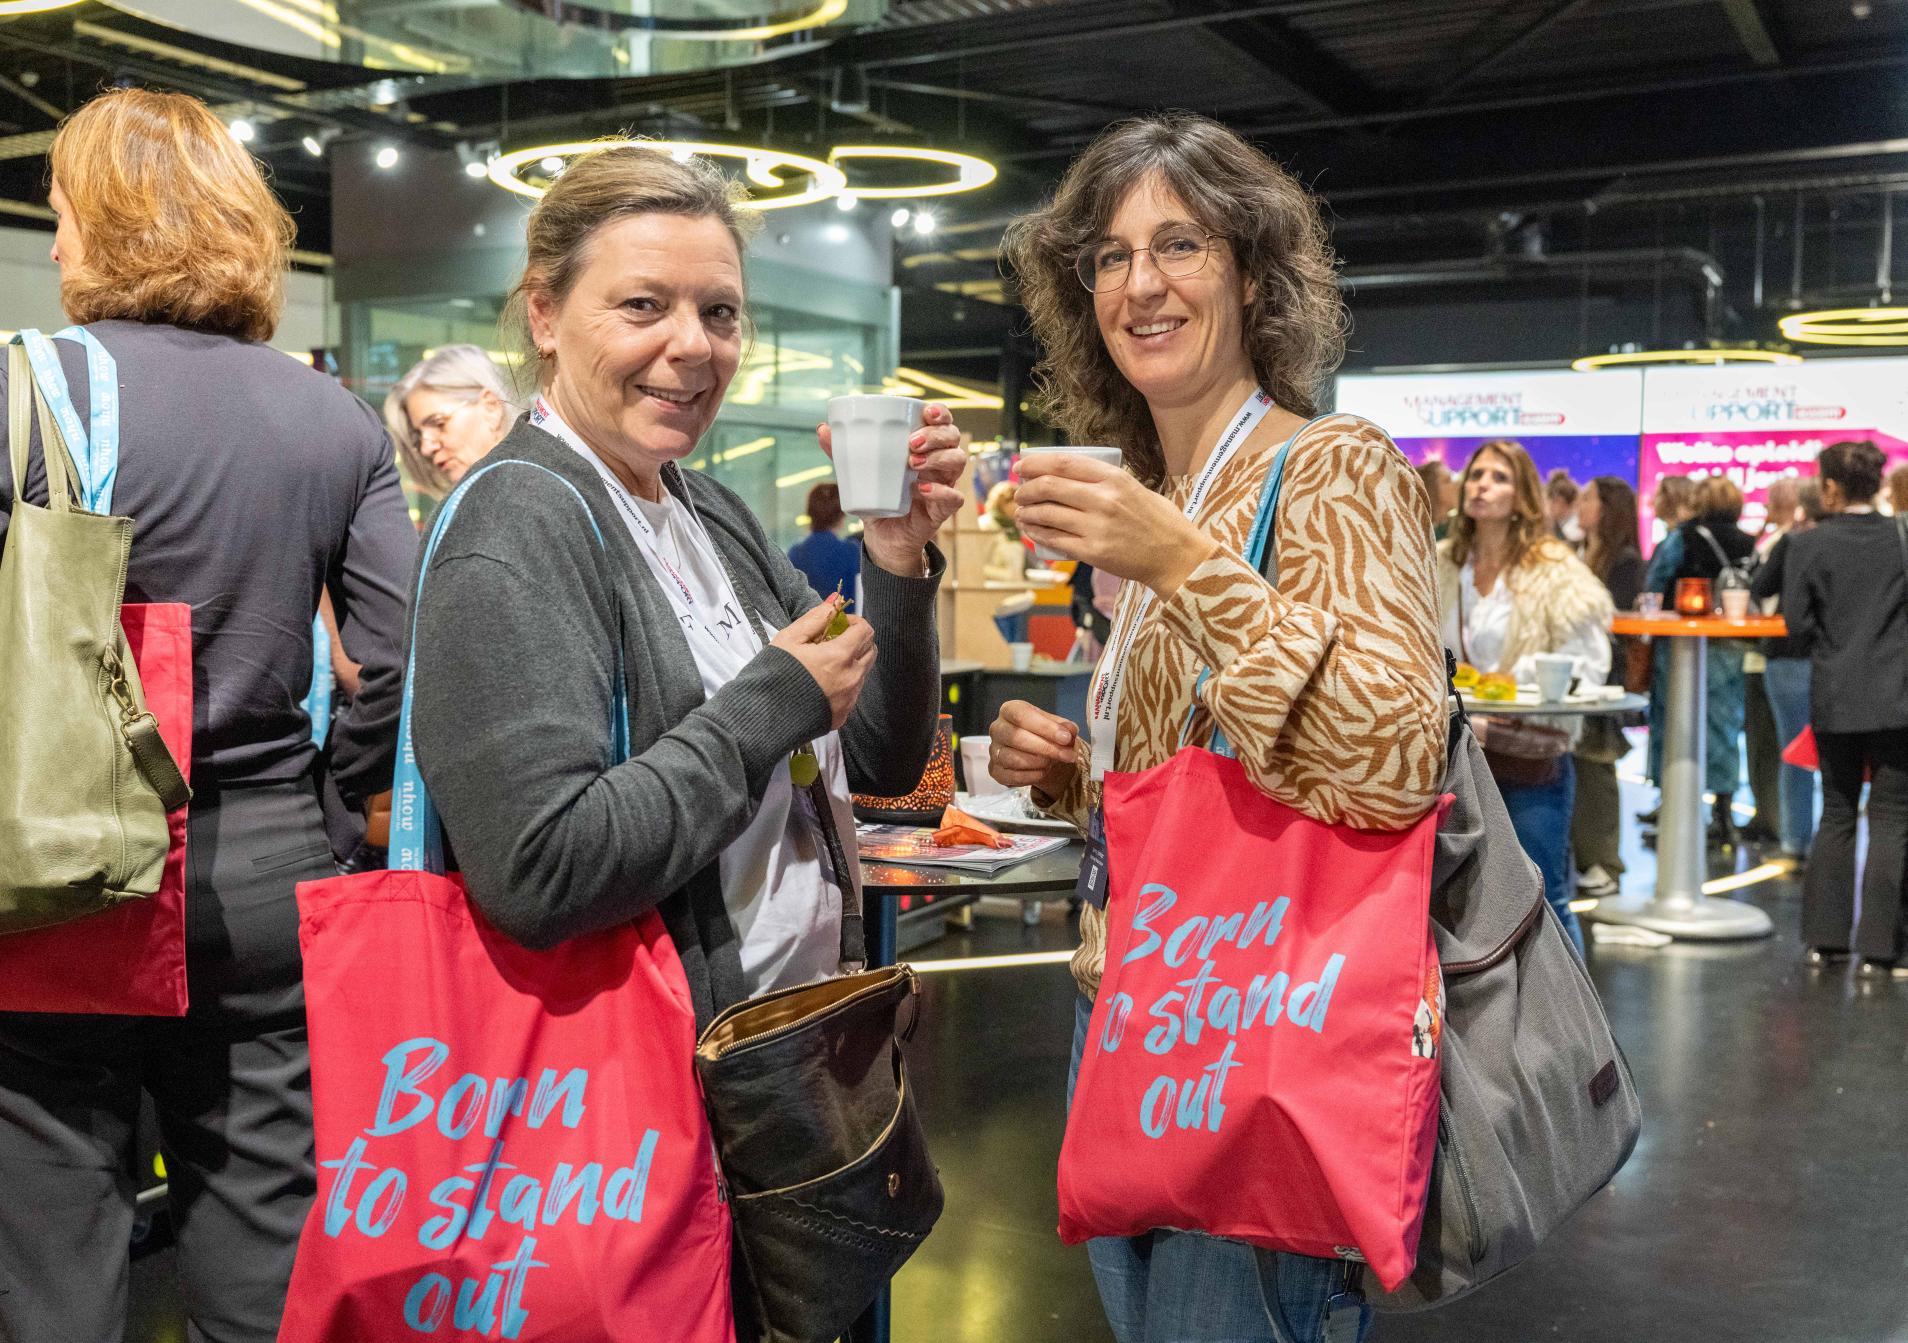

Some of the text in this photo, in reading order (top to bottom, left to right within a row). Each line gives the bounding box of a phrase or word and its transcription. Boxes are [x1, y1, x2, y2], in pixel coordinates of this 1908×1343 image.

[1187, 411, 1252, 514] www.managementsupport.nl
[402, 780, 417, 831] nhow
[1144, 952, 1347, 1055] stand
[363, 1036, 589, 1140] Born
[1140, 1040, 1245, 1139] out
[319, 1128, 661, 1251] to stand
[402, 1235, 550, 1341] out
